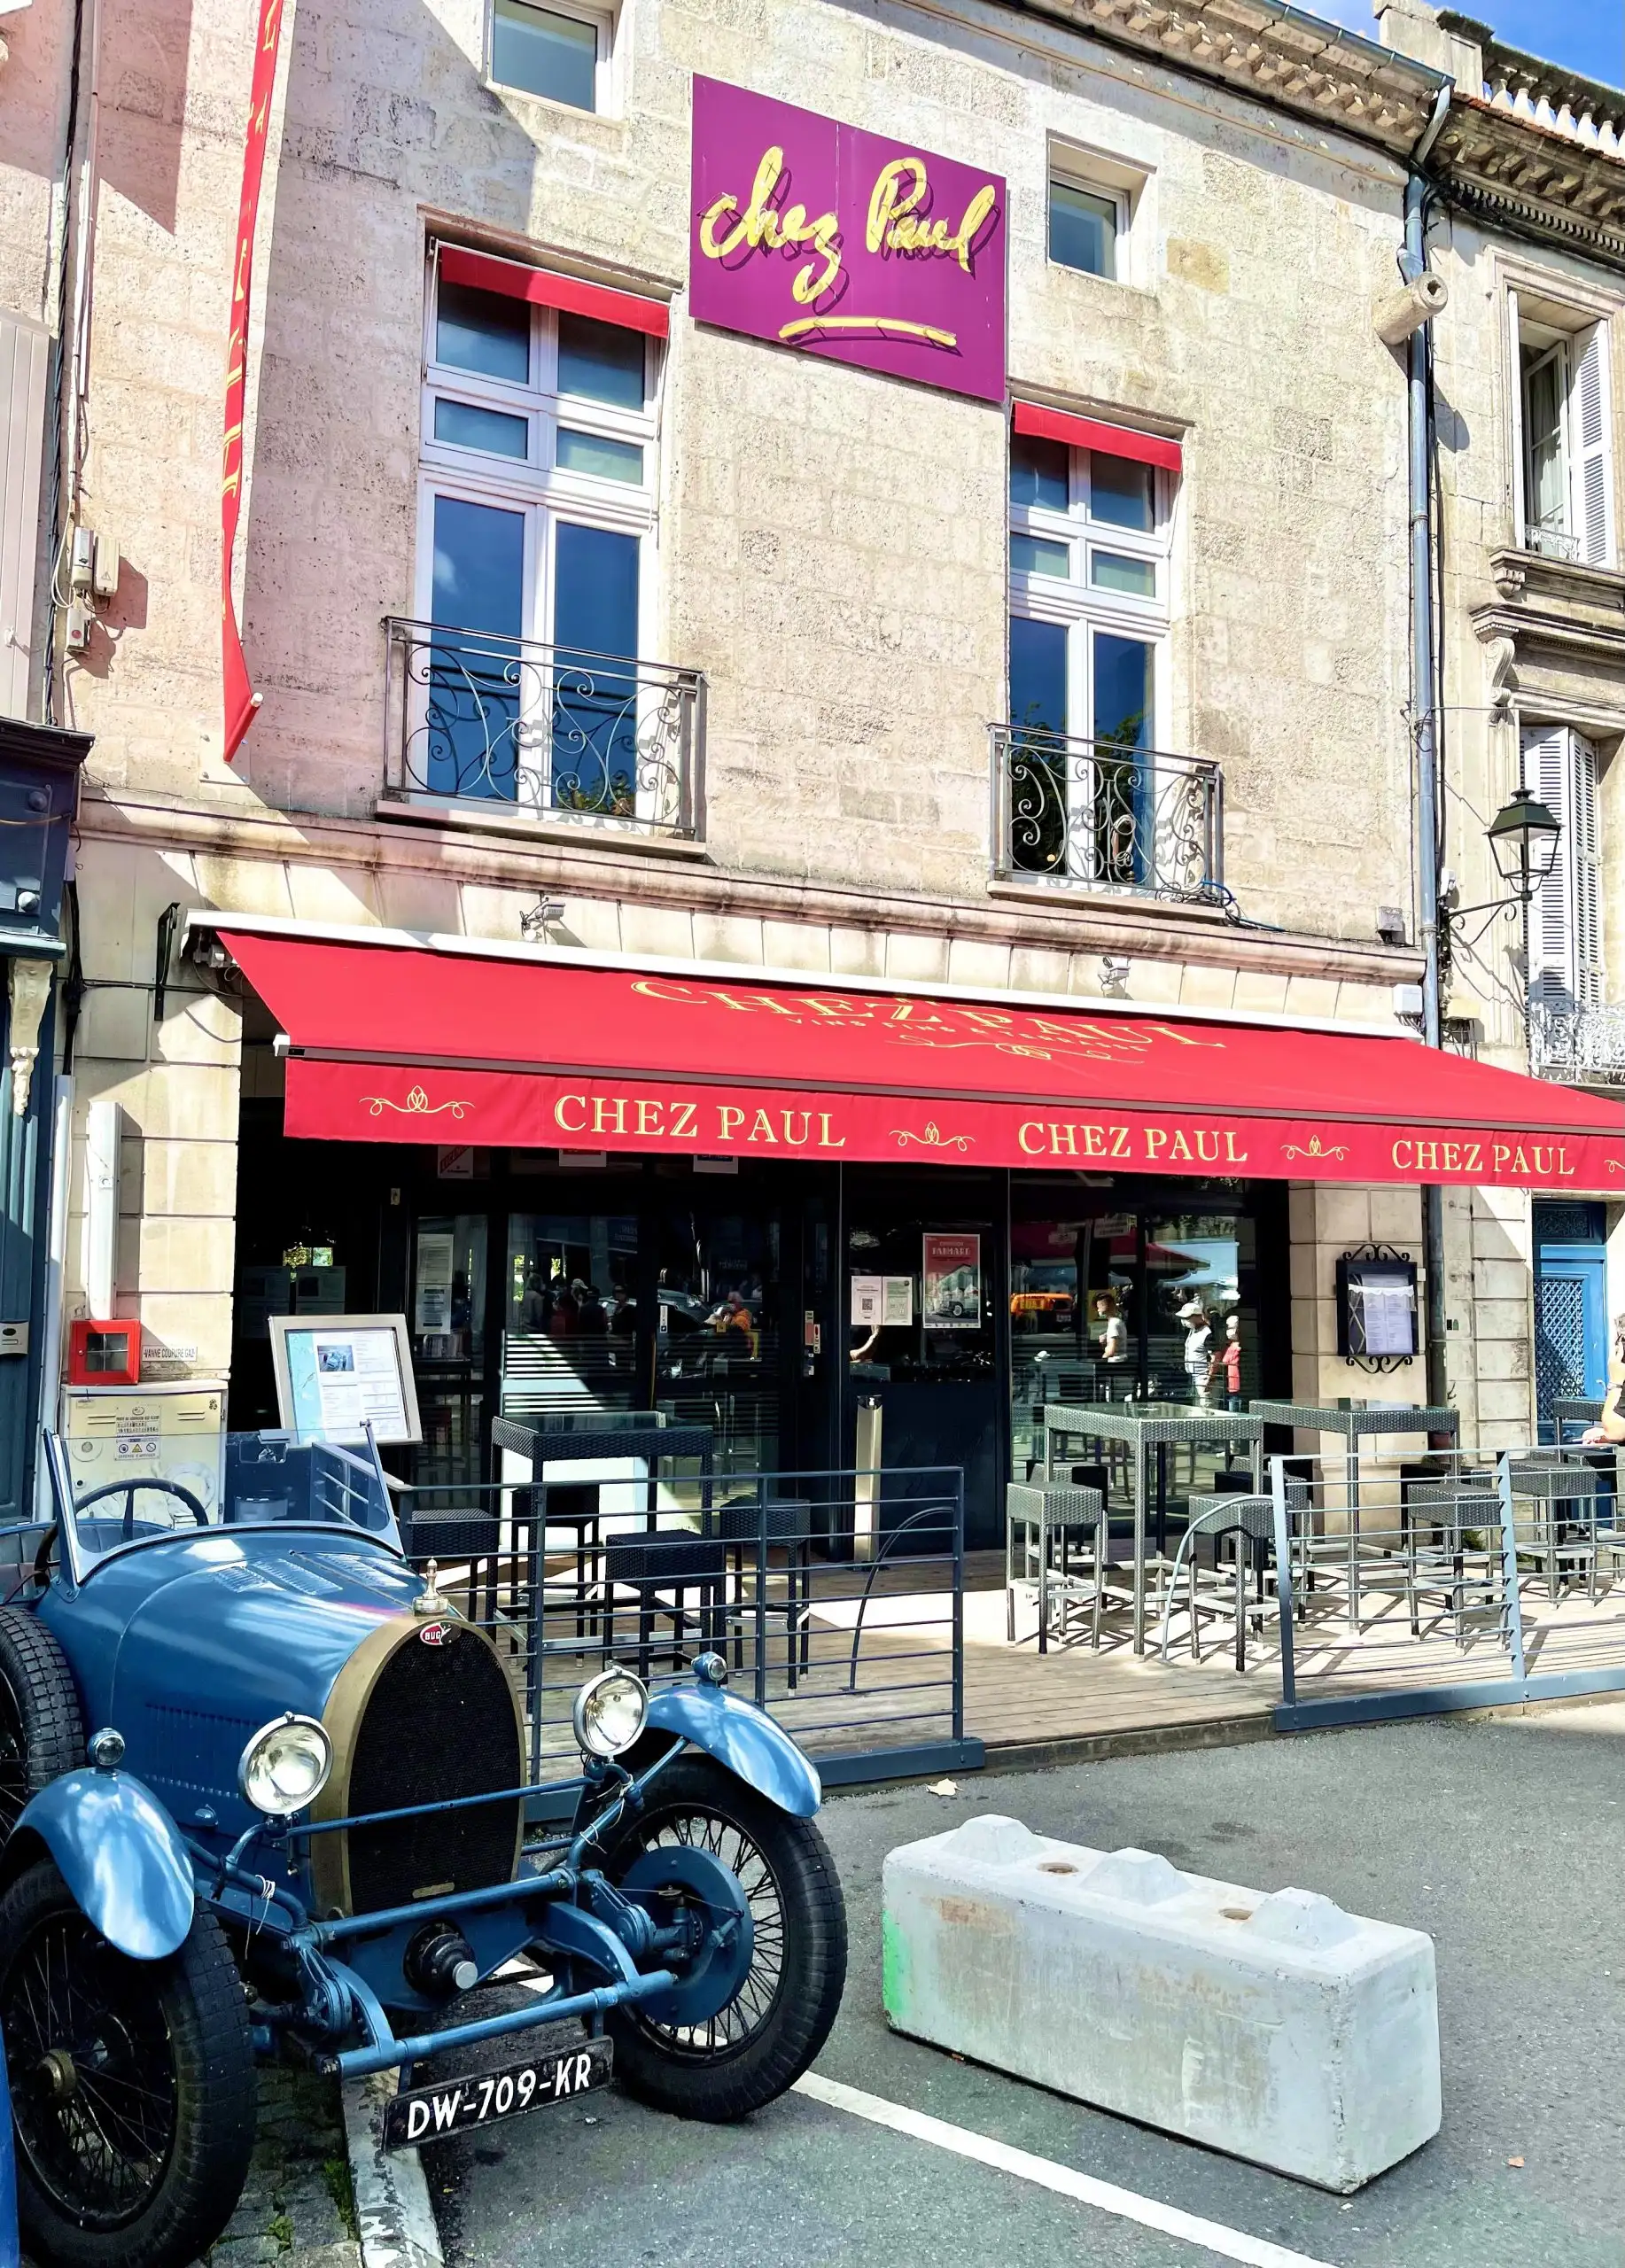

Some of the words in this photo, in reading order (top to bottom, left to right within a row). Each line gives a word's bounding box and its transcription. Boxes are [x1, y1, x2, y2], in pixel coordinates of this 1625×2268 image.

[865, 156, 997, 274] Paul
[630, 981, 945, 1024] CHEZ
[945, 1008, 1227, 1049] PAUL
[554, 1094, 698, 1138] CHEZ
[715, 1105, 847, 1147] PAUL
[1018, 1122, 1131, 1158] CHEZ
[1143, 1128, 1248, 1162] PAUL
[1391, 1139, 1483, 1172] CHEZ
[1492, 1145, 1575, 1176] PAUL
[407, 2053, 592, 2140] DW-709-KR
